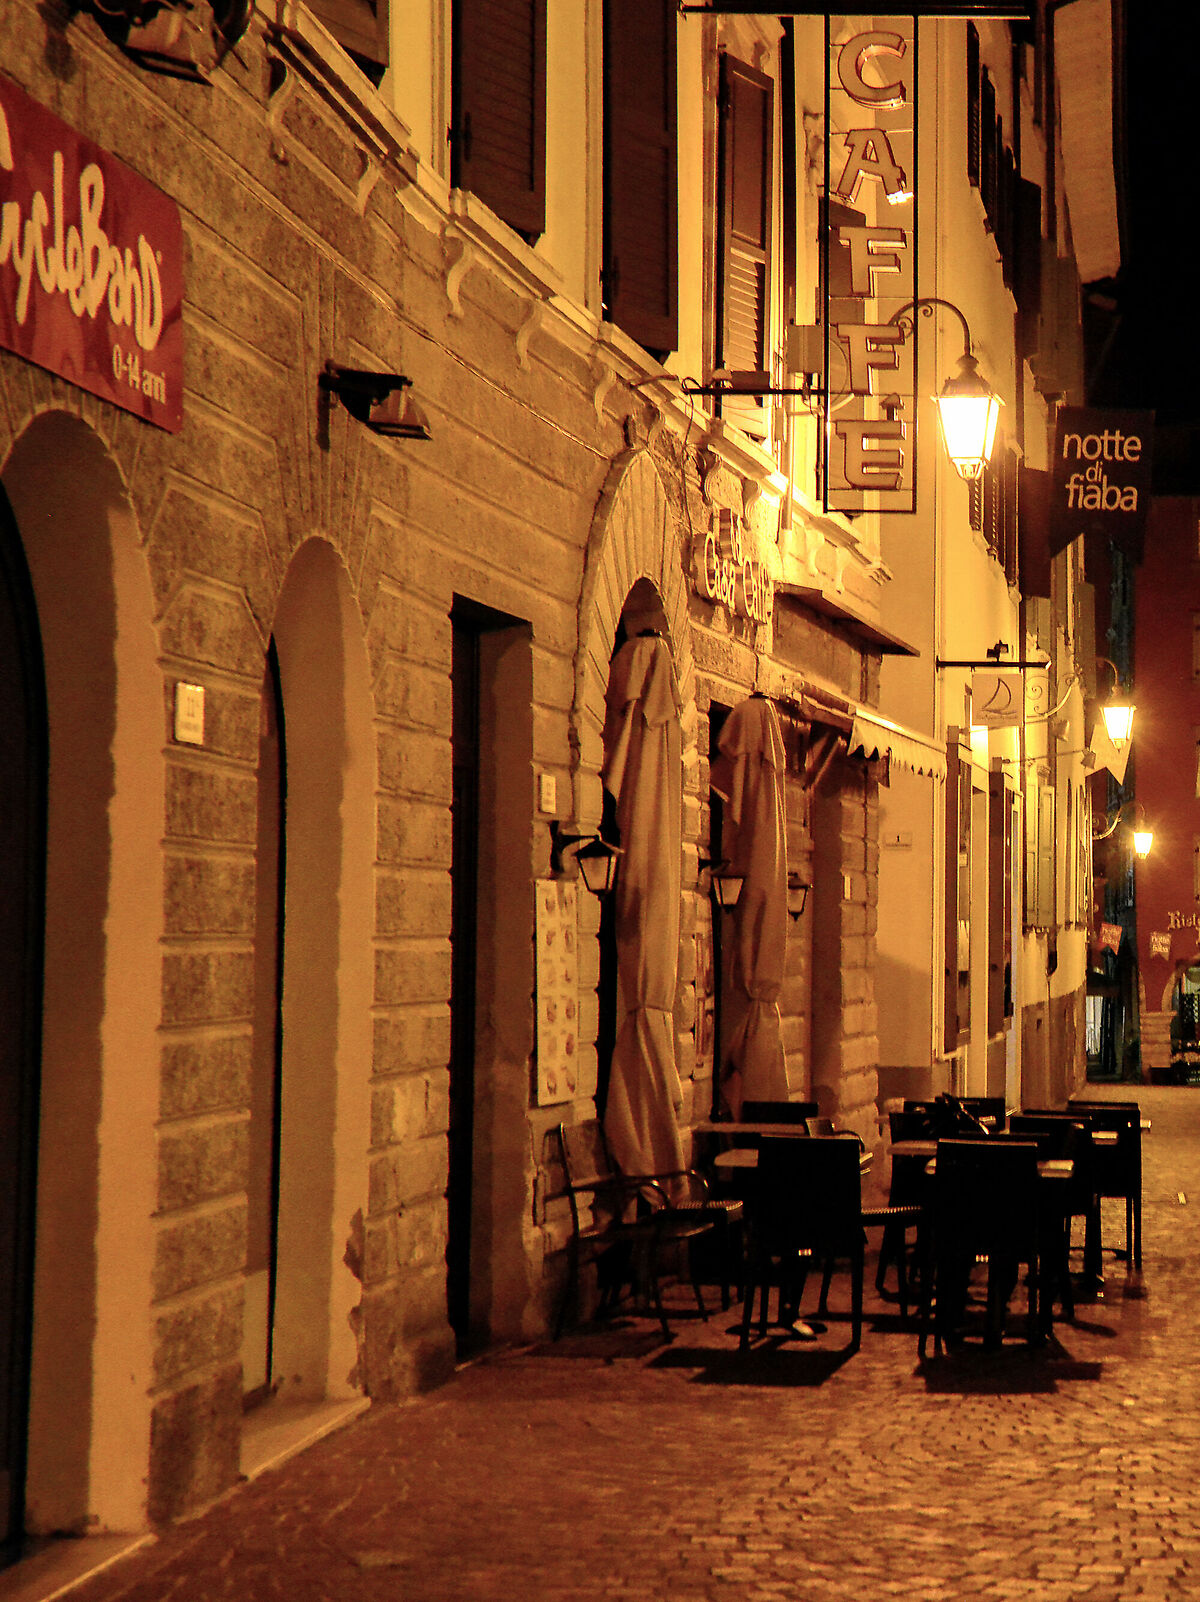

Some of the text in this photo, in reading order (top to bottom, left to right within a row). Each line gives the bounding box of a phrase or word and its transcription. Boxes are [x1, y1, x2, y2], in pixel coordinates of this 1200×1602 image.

[1063, 429, 1141, 461] notte
[1086, 461, 1103, 482] di
[1065, 473, 1138, 512] fiaba
